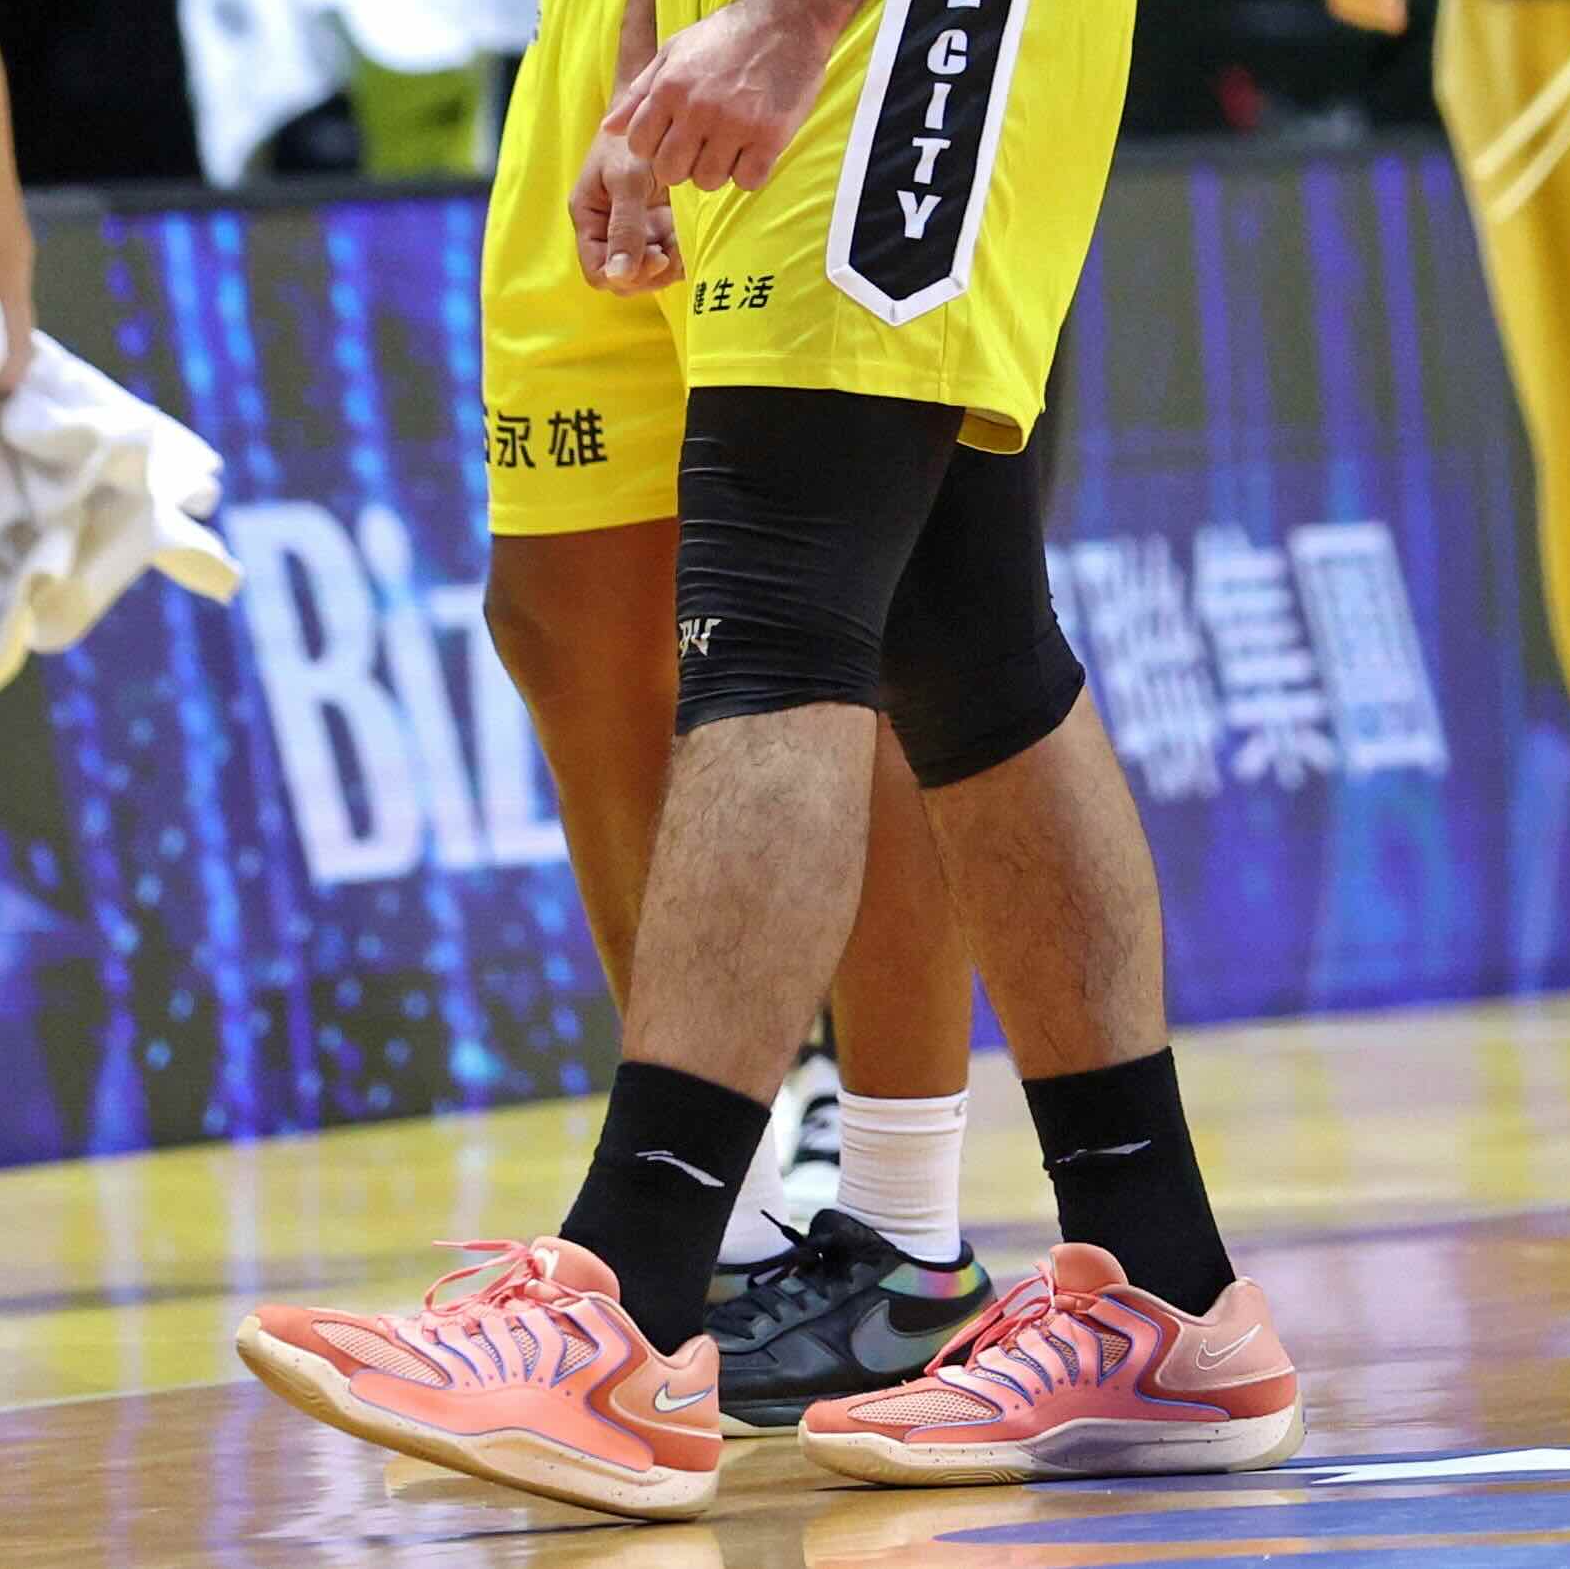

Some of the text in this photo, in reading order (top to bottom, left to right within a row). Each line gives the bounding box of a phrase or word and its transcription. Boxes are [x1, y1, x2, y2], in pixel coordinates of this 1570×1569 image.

[897, 29, 967, 239] CITY
[485, 408, 608, 469] 永雄
[1044, 520, 1450, 803] 聯集團
